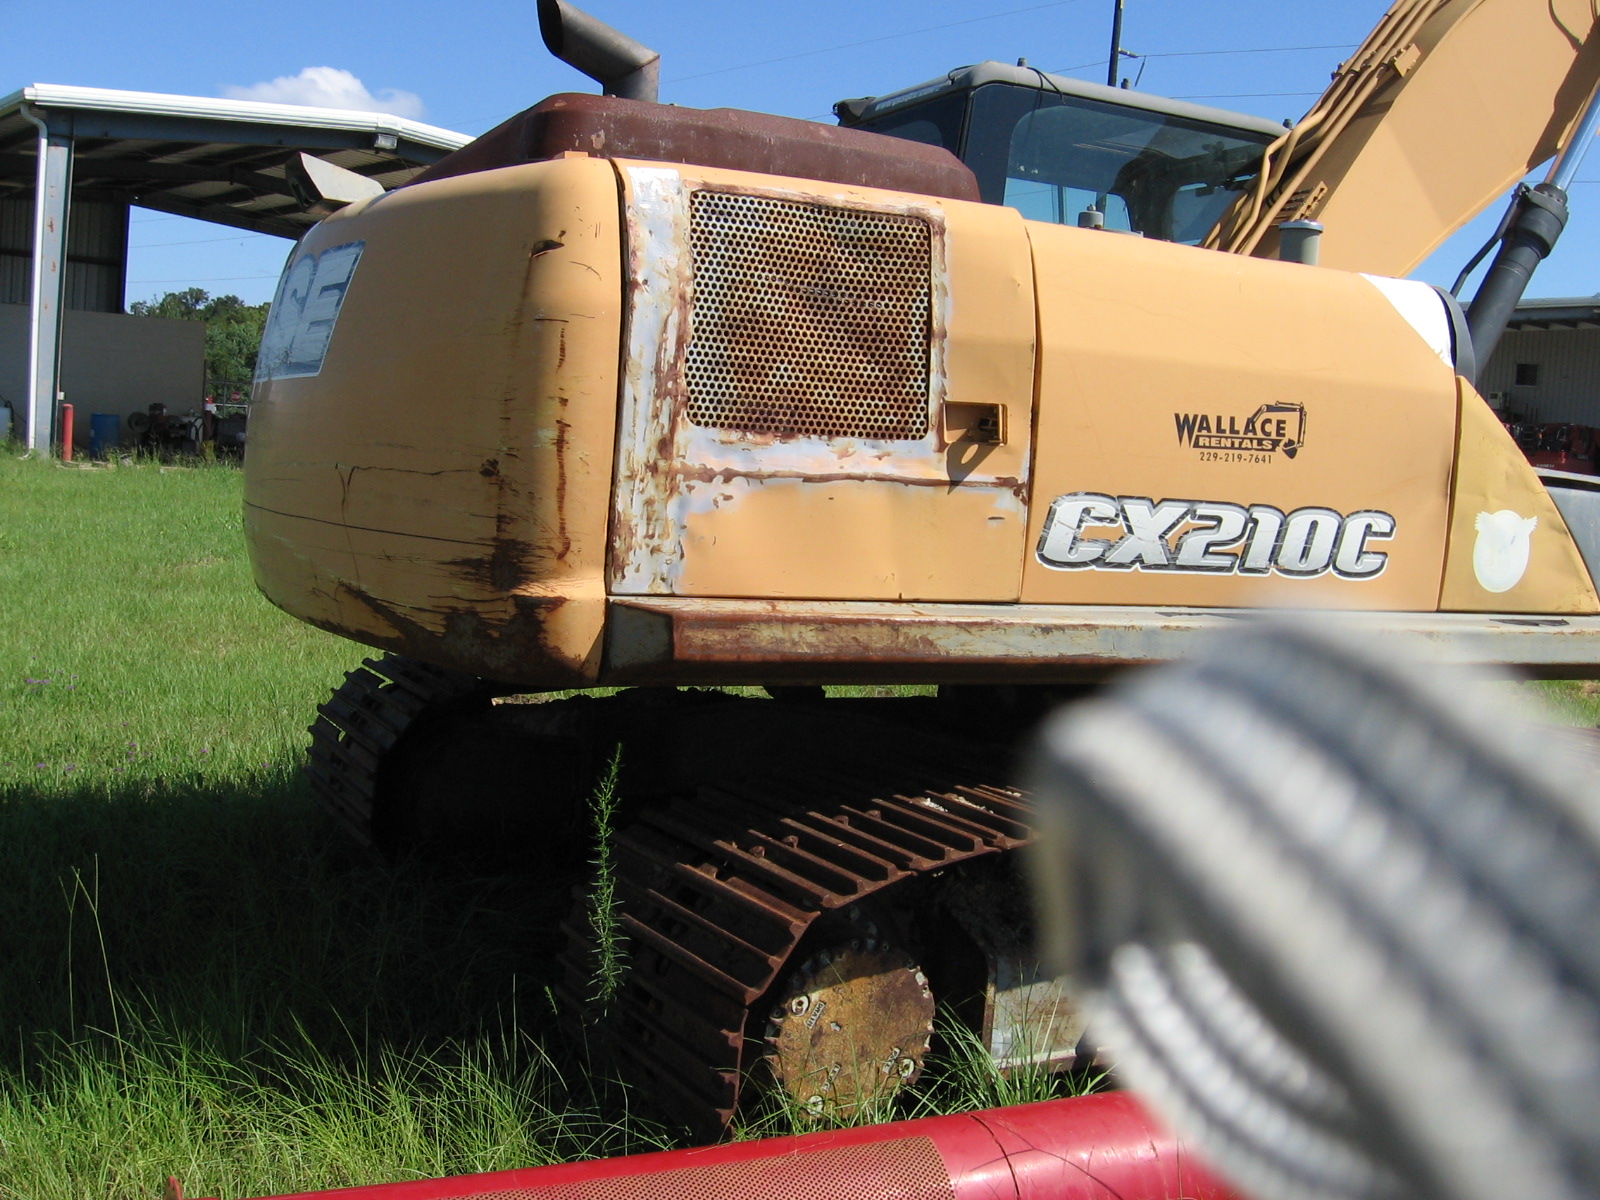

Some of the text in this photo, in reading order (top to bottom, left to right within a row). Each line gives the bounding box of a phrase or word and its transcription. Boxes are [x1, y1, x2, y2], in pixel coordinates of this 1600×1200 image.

[1174, 412, 1287, 448] WALLACE
[1198, 436, 1274, 450] RENTALS
[1199, 451, 1273, 464] 229-219-7641
[1035, 491, 1397, 581] CX210C
